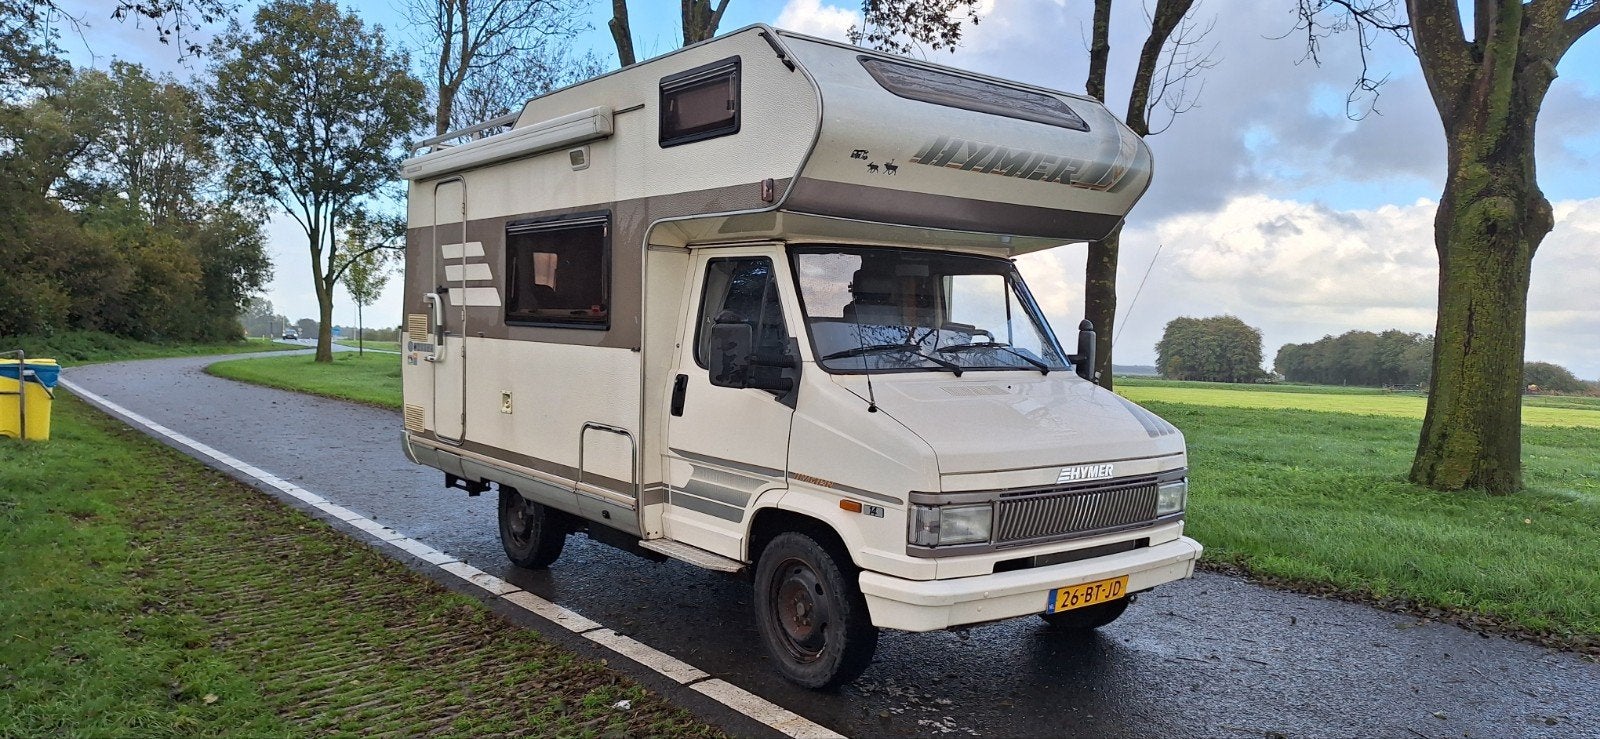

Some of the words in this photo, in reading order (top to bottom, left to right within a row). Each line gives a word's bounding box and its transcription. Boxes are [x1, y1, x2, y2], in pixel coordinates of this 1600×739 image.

[916, 135, 1085, 184] HYMER
[1069, 464, 1114, 480] HYMER
[869, 506, 878, 516] 14
[1061, 580, 1122, 608] 26-BT-JD
